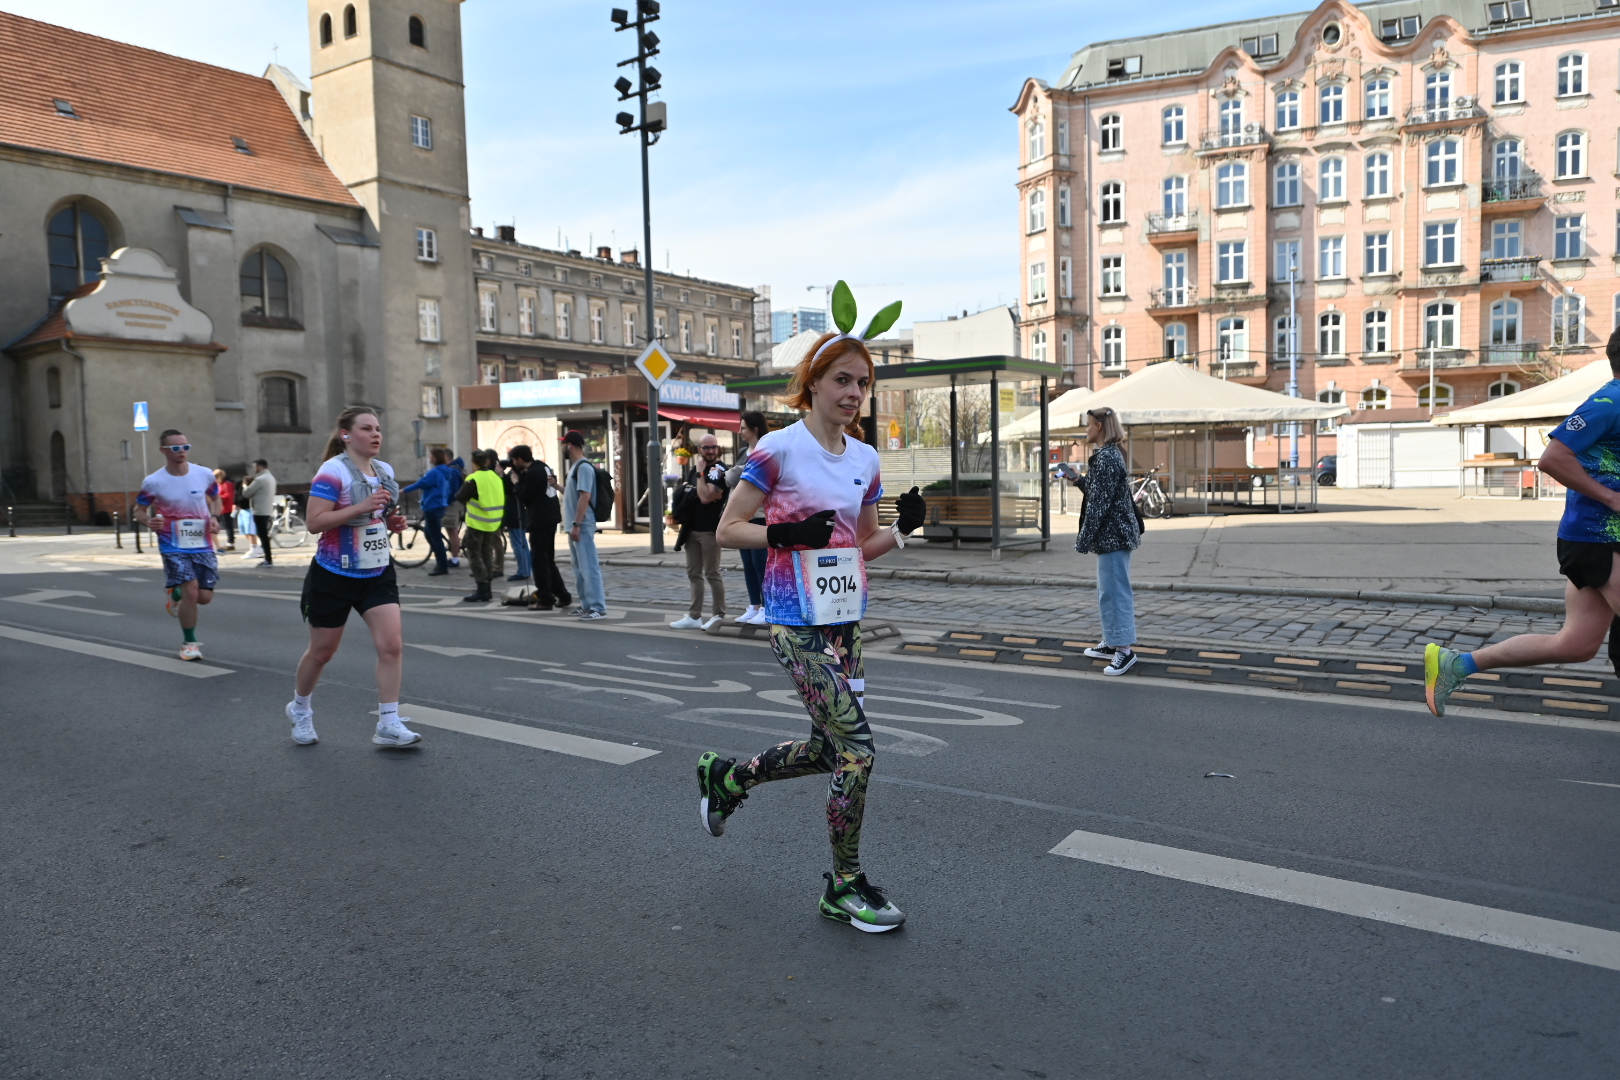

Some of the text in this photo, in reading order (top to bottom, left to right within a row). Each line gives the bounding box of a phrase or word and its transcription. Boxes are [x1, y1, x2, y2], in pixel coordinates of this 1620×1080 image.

[661, 383, 738, 405] KWIACIARNIA
[1568, 417, 1583, 430] 105
[180, 529, 203, 537] 11666
[363, 537, 387, 551] 9358
[816, 575, 857, 595] 9014
